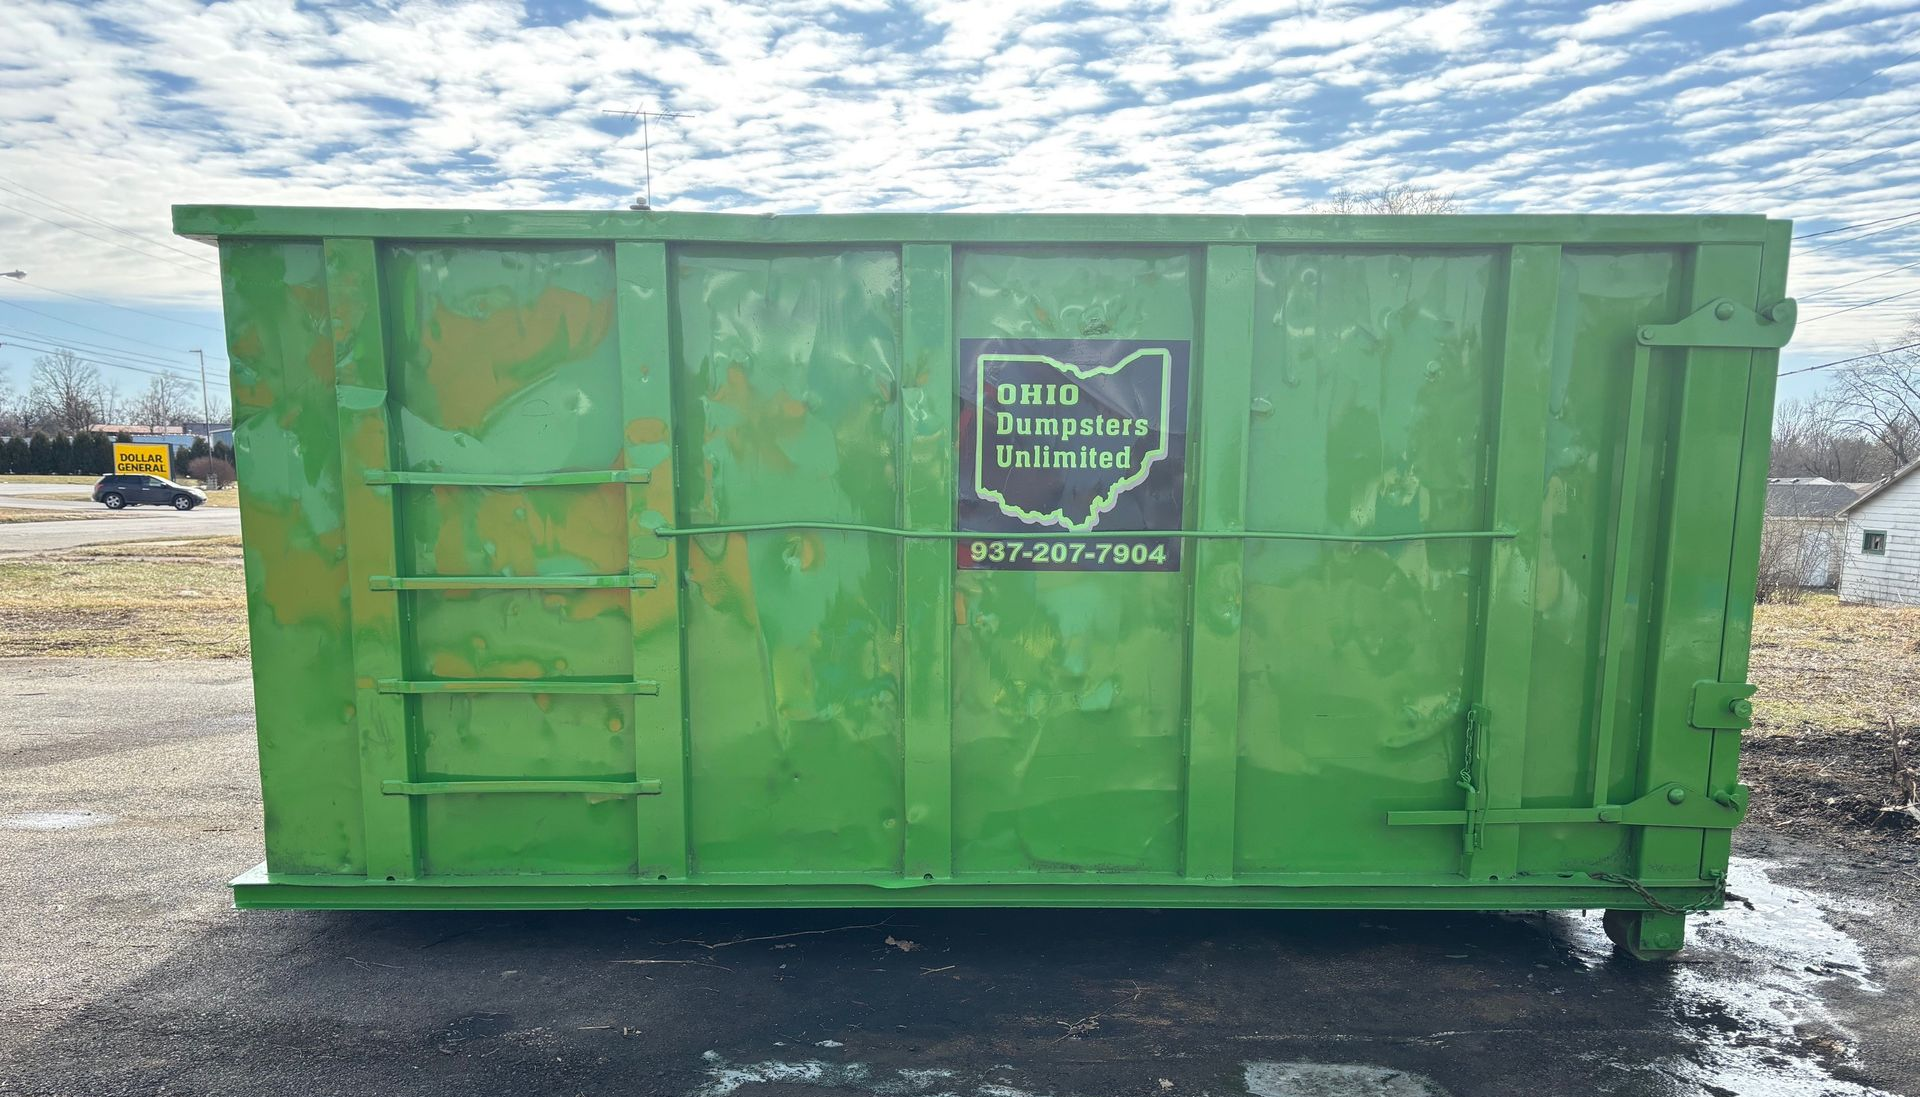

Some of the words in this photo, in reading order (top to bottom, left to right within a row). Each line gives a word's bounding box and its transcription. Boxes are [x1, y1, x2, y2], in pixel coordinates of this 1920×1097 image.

[997, 383, 1079, 405] OHIO
[996, 412, 1149, 441] Dumpsters
[117, 463, 166, 473] GENERAL
[120, 453, 163, 463] DOLLAR
[996, 445, 1131, 469] Unlimited
[970, 541, 1167, 564] 937-207-7904
